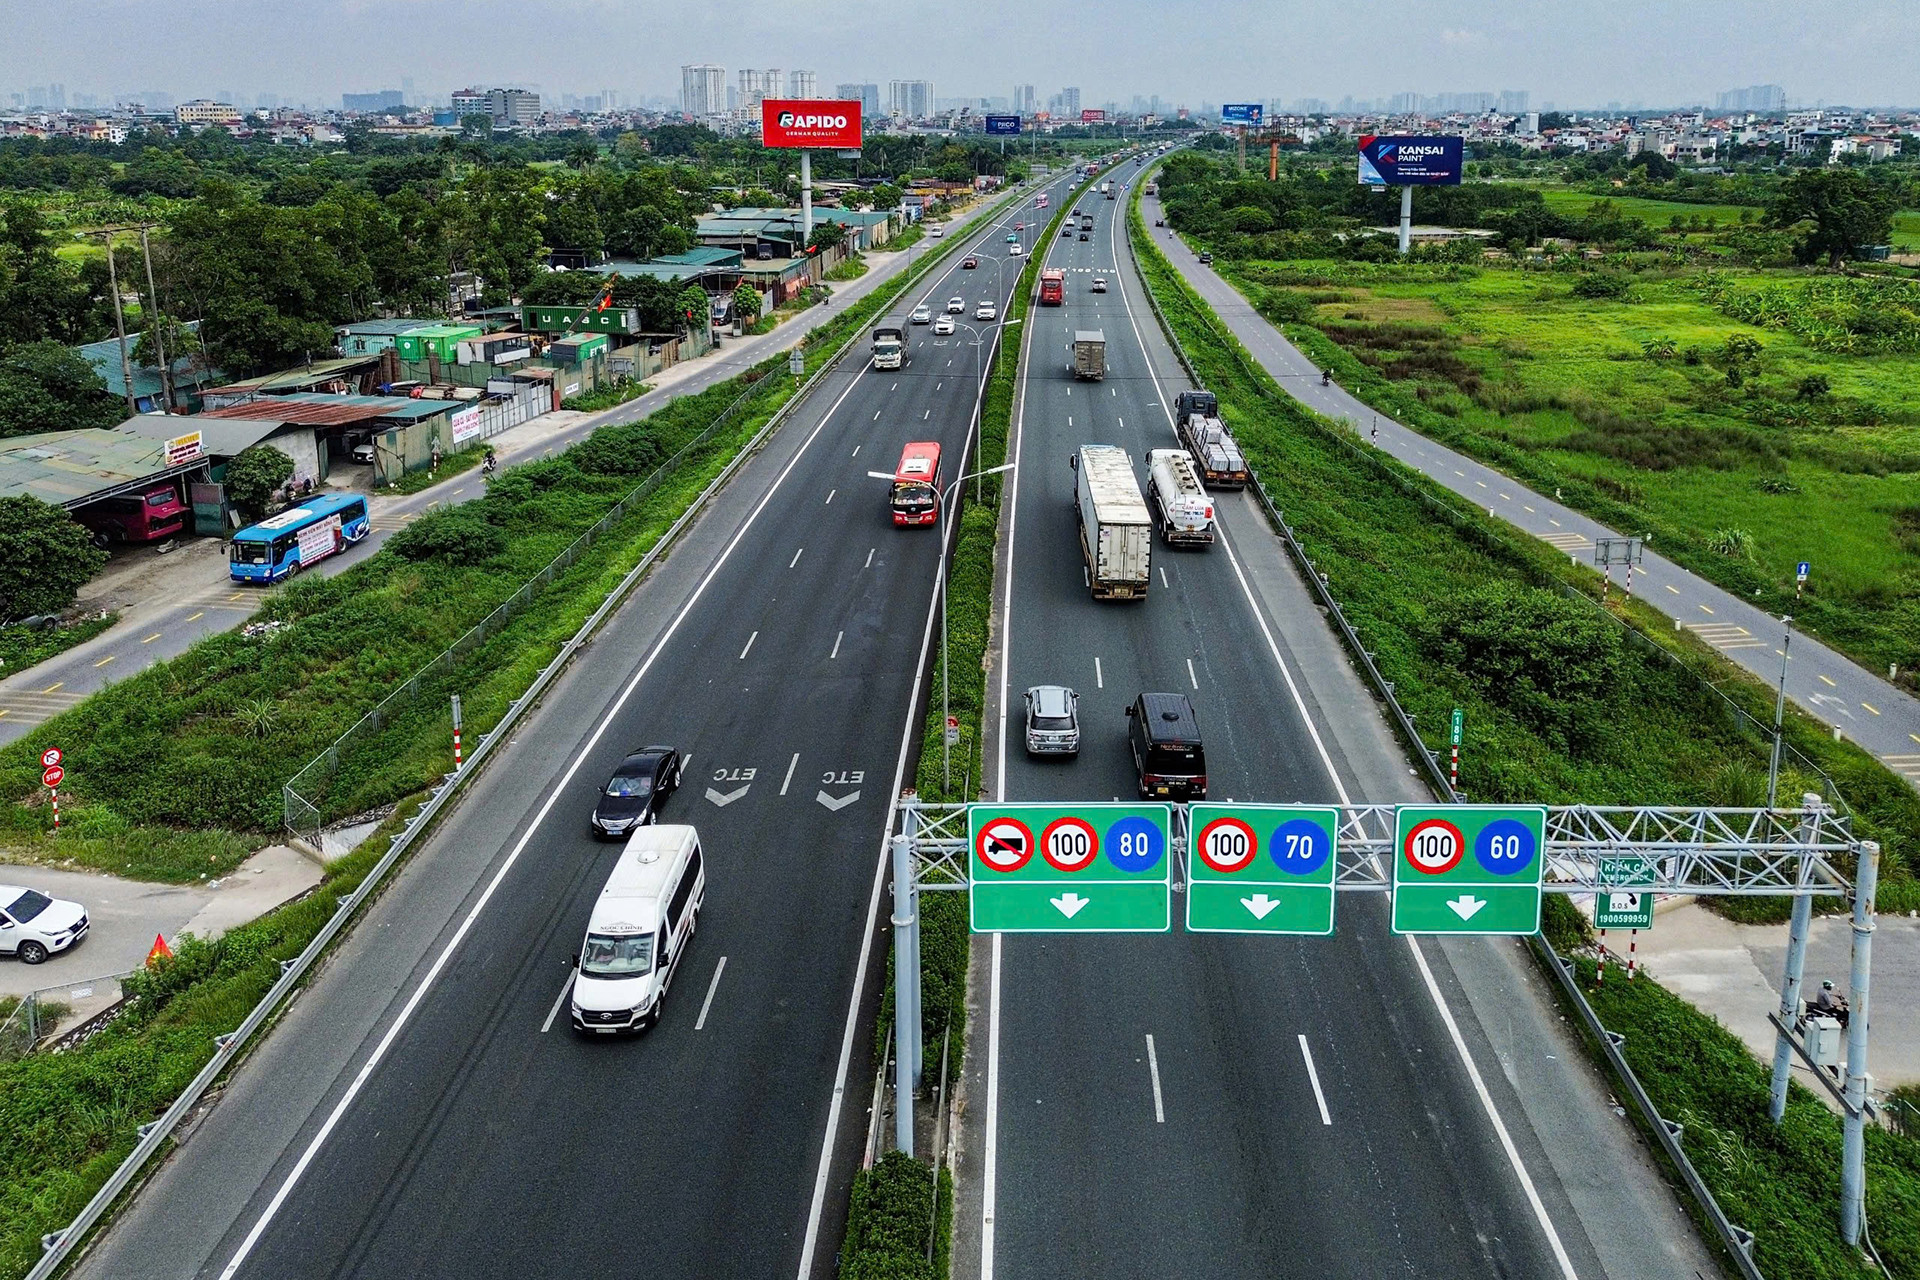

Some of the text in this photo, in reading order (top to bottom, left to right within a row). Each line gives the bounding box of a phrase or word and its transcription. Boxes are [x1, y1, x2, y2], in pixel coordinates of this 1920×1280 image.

[779, 113, 847, 128] RAPIDO
[1398, 146, 1444, 155] KANSAI
[46, 770, 61, 782] STOP
[713, 768, 757, 781] ETC
[821, 771, 865, 784] ETC
[1053, 833, 1087, 856] 100
[1120, 833, 1148, 857] 80
[1212, 833, 1245, 856] 100
[1286, 835, 1313, 859] 70
[1418, 835, 1452, 858] 100
[1490, 835, 1519, 859] 60
[1600, 914, 1648, 923] 1900599959
